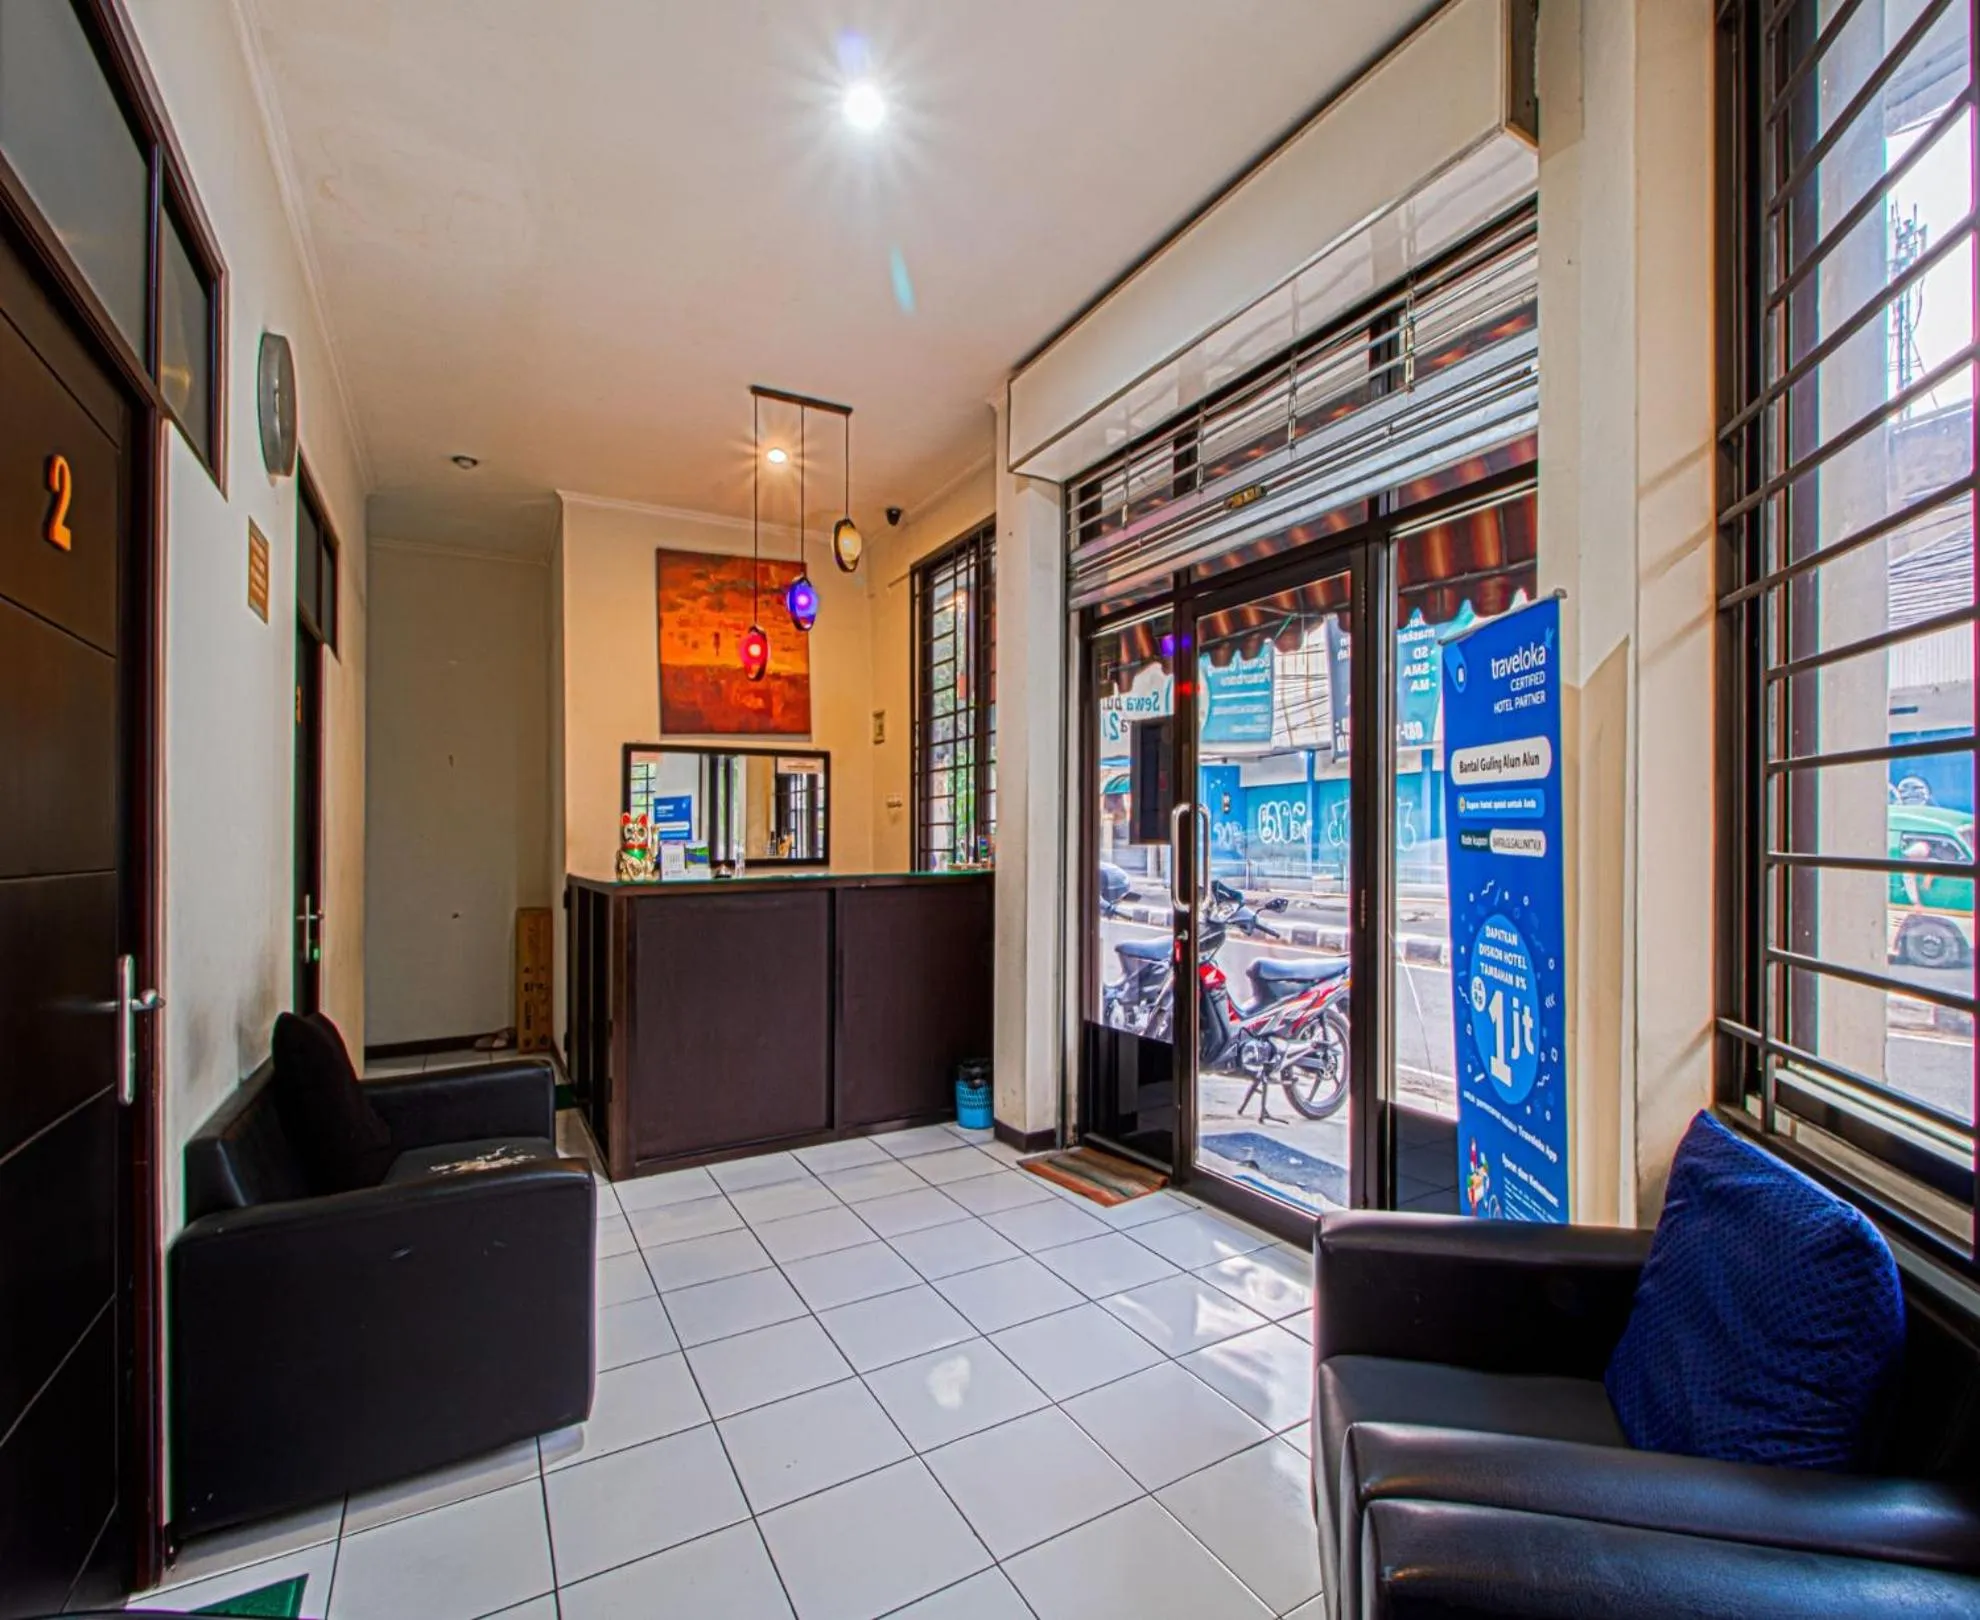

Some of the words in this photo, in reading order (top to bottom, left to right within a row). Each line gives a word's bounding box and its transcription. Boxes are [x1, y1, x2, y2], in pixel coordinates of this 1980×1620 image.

[48, 455, 72, 551] 2
[1491, 643, 1546, 680] traveloka
[1510, 671, 1545, 692] CERTIFIED
[1494, 698, 1513, 714] HOTEL
[1515, 690, 1546, 709] PARTNER
[1459, 758, 1479, 773] Bantal
[1480, 756, 1502, 774] Guling
[1523, 752, 1540, 766] Alun
[1485, 925, 1518, 946] DAPATKAN
[1479, 943, 1503, 961] DISKON
[1503, 948, 1527, 970] HOTEL
[1480, 962, 1514, 986] TAMBAHAN
